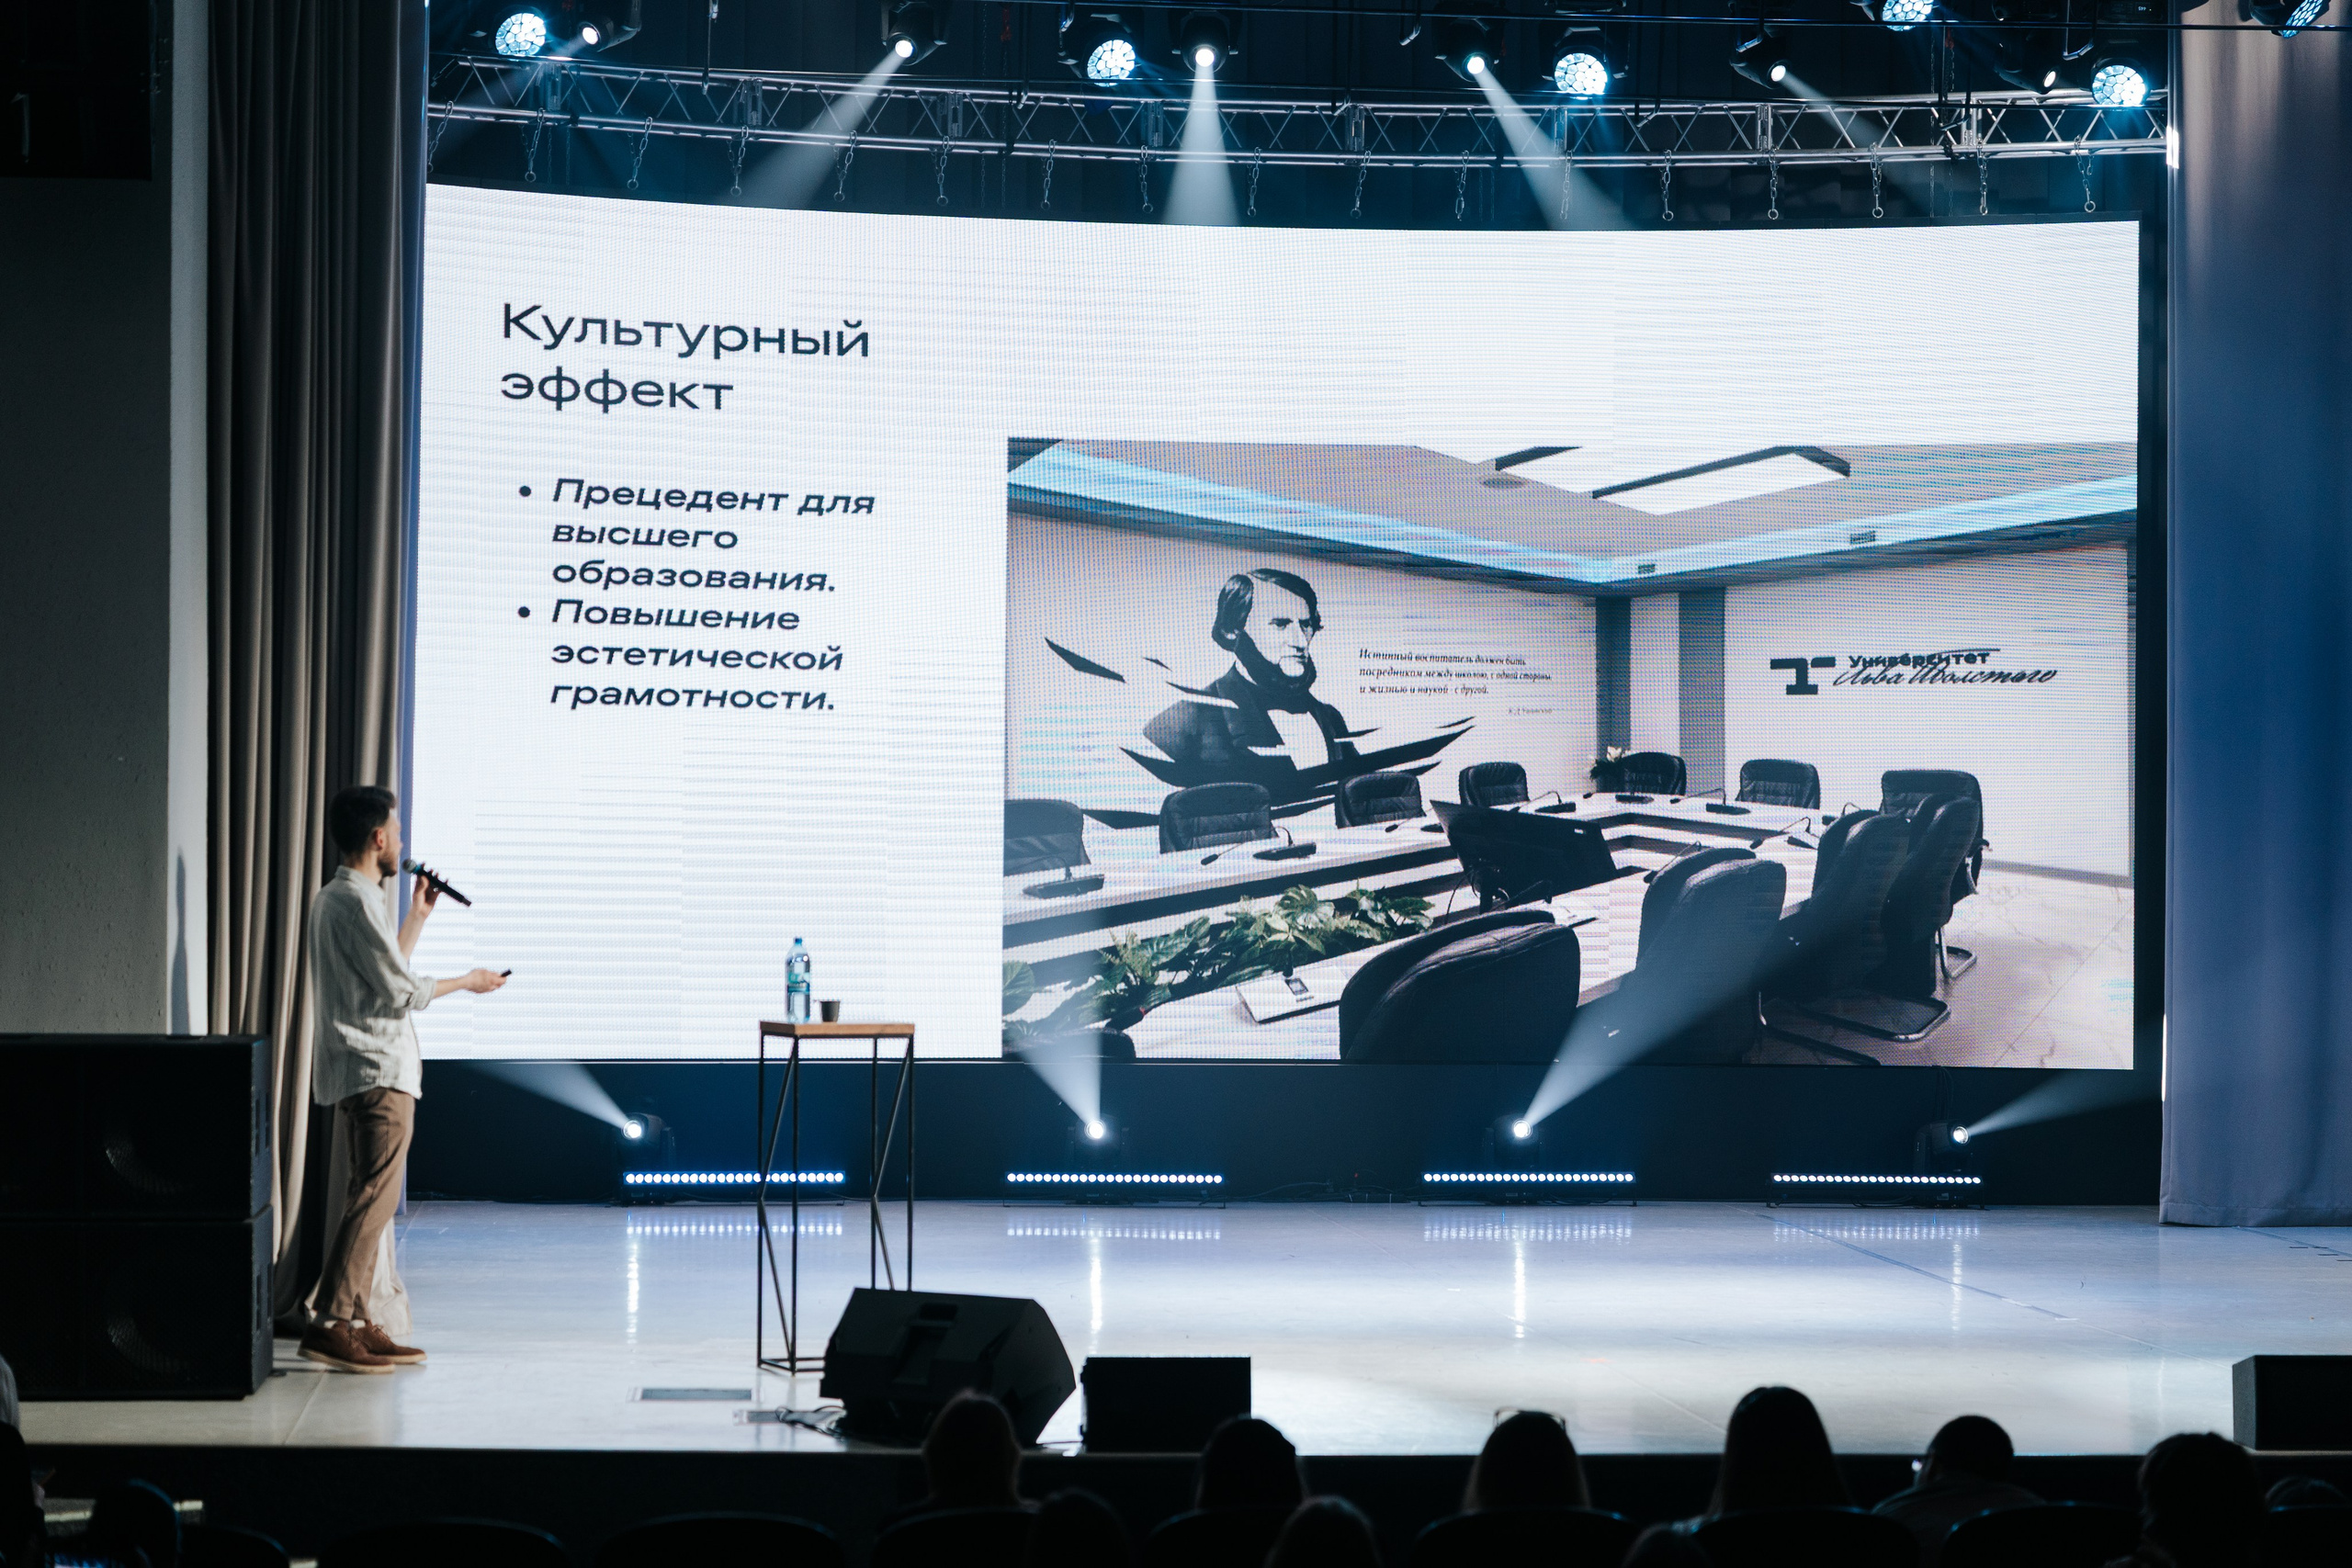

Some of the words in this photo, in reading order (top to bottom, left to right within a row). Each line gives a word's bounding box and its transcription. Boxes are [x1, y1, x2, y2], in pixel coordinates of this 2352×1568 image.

[503, 302, 869, 359] Культурный
[501, 366, 734, 414] эффект
[552, 478, 789, 513] Прецедент
[797, 493, 876, 516] для
[551, 524, 739, 549] высшего
[551, 559, 836, 592] образования.
[551, 598, 800, 631] Повышение
[550, 645, 843, 671] эстетической
[1359, 649, 1413, 662] Истинный
[1359, 666, 1422, 680] посредником
[549, 684, 835, 711] грамотности.
